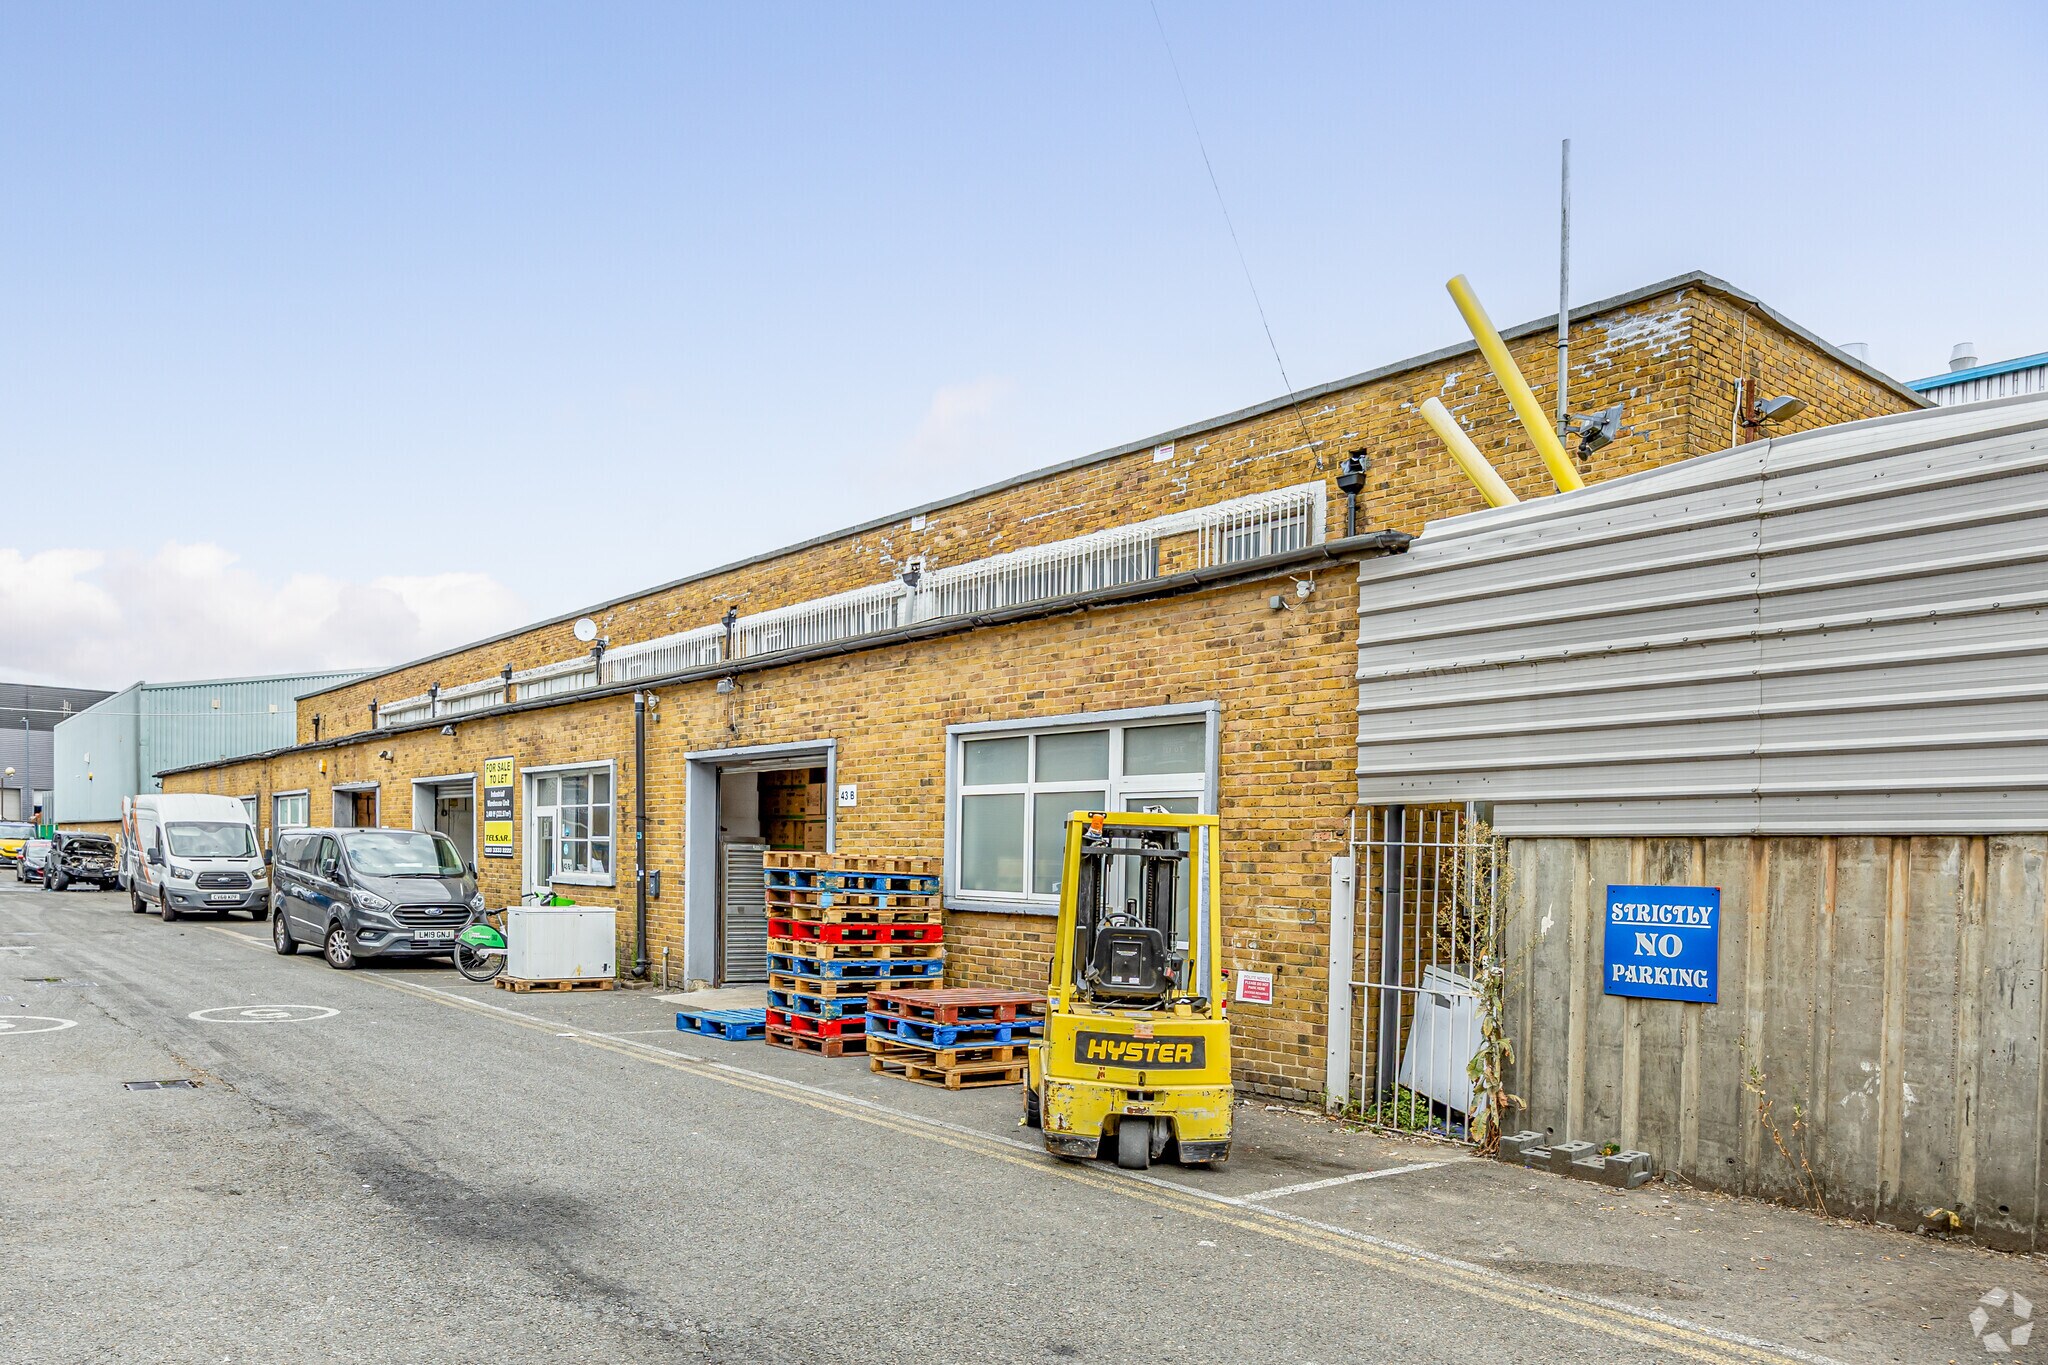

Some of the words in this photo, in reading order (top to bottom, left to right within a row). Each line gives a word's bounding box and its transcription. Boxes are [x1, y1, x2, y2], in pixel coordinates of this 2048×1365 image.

[486, 763, 496, 772] FOR
[497, 762, 510, 771] SALE
[490, 775, 496, 783] TO
[498, 774, 507, 783] LET
[841, 791, 848, 800] 43
[850, 791, 854, 799] B
[1611, 902, 1713, 925] STRICTLY
[419, 931, 435, 939] LM19
[1633, 932, 1683, 958] NO
[1612, 963, 1708, 989] PARKING
[1087, 1038, 1194, 1064] HYSTER
